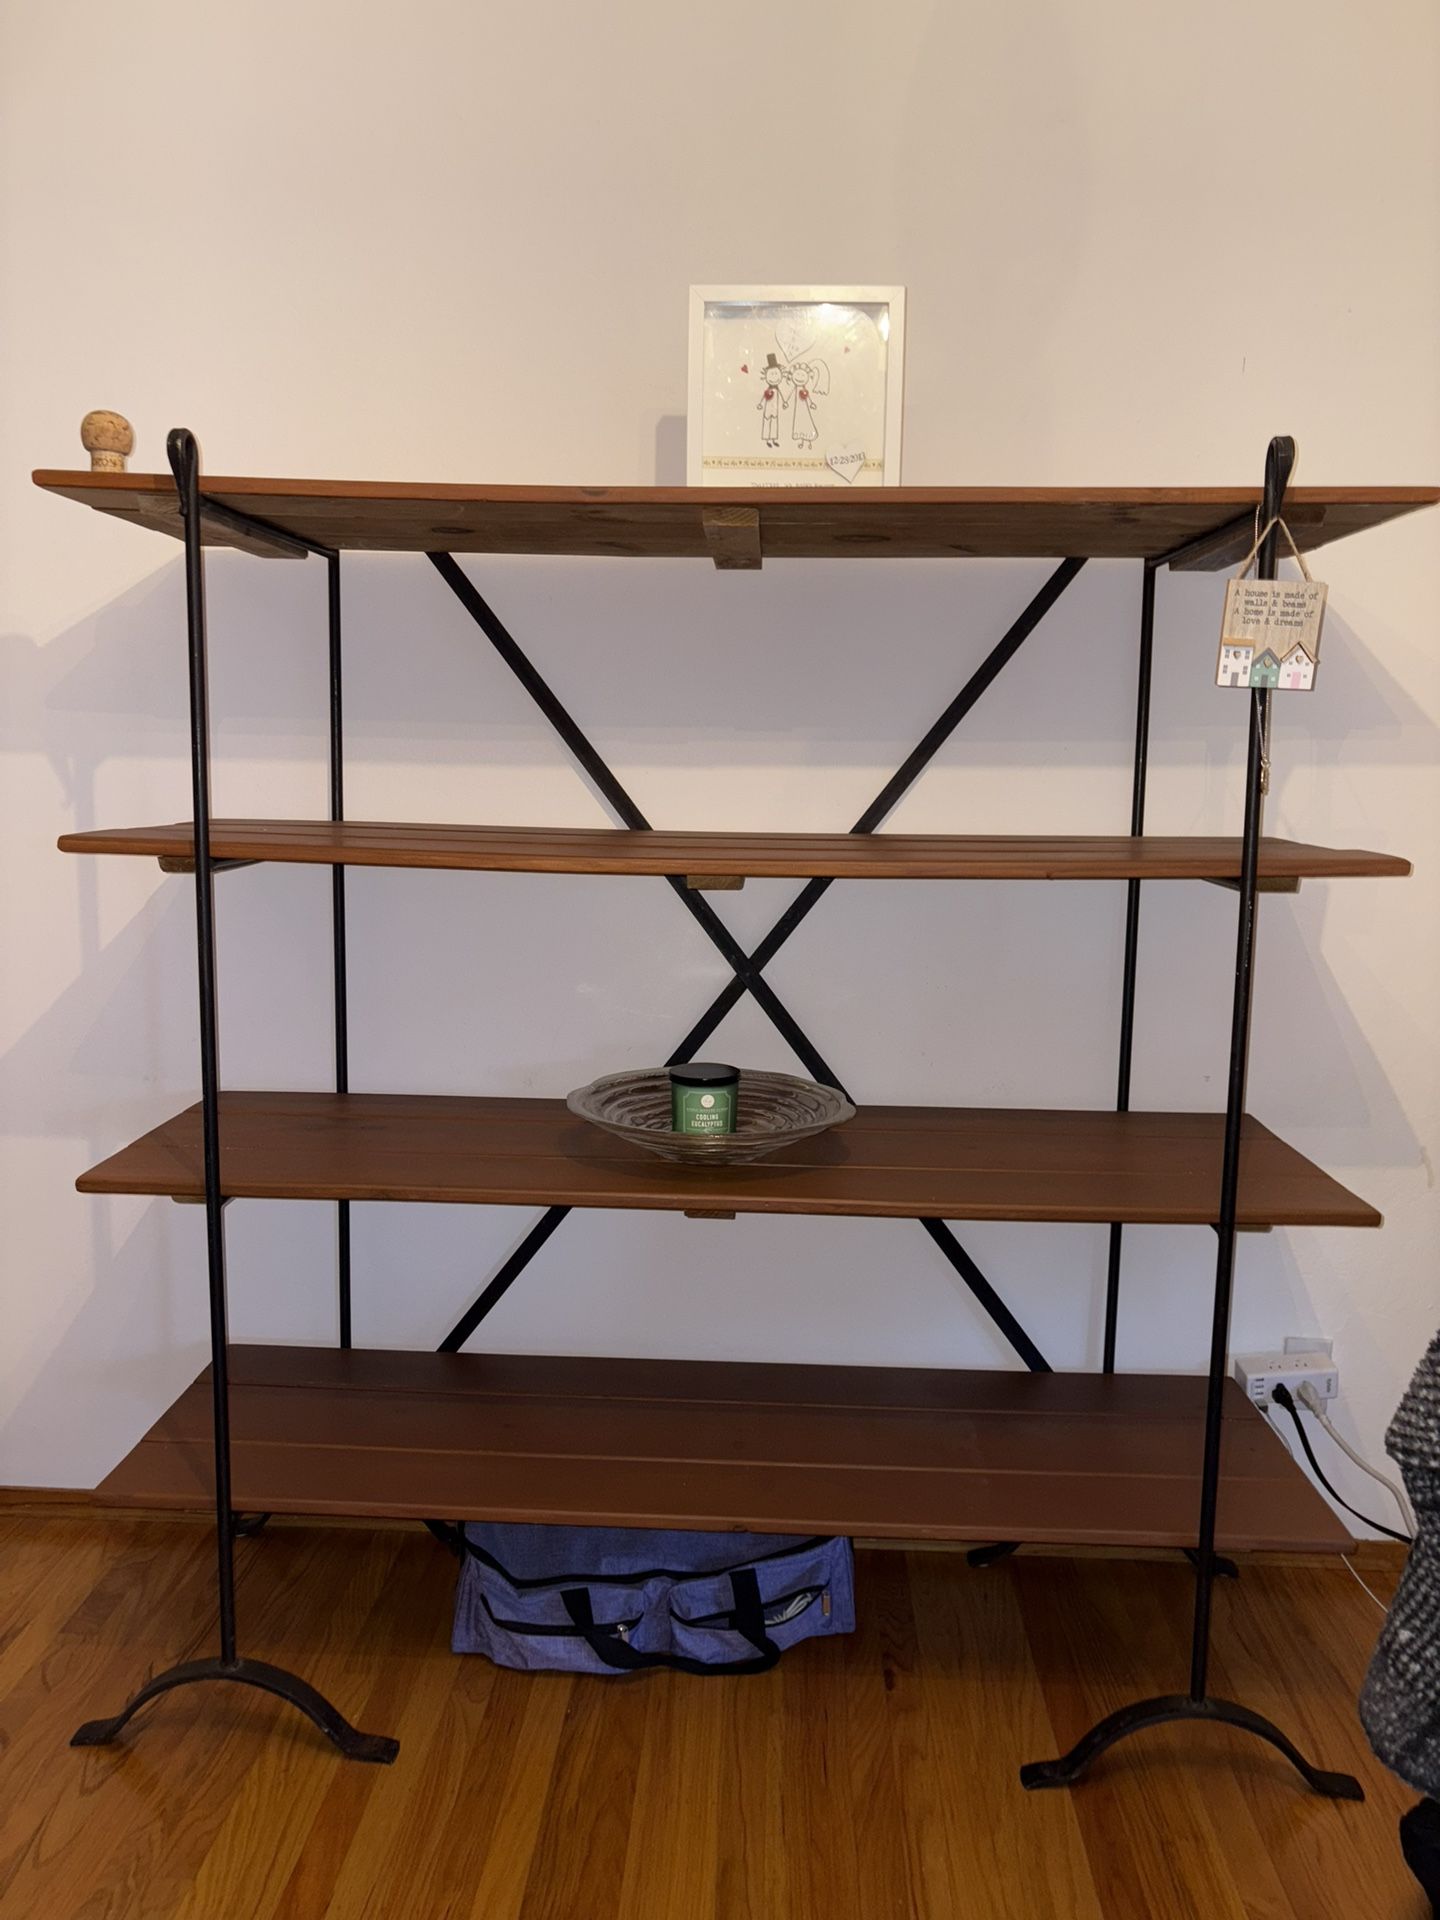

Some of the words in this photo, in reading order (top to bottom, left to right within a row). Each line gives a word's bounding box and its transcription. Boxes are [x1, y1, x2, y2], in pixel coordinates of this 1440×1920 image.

[1244, 589, 1268, 598] house
[1272, 590, 1280, 598] is
[1284, 591, 1305, 599] made
[1282, 600, 1307, 608] beams
[1244, 608, 1264, 616] home
[1267, 608, 1276, 616] is
[1242, 617, 1260, 625] love
[1274, 618, 1303, 626] dreams
